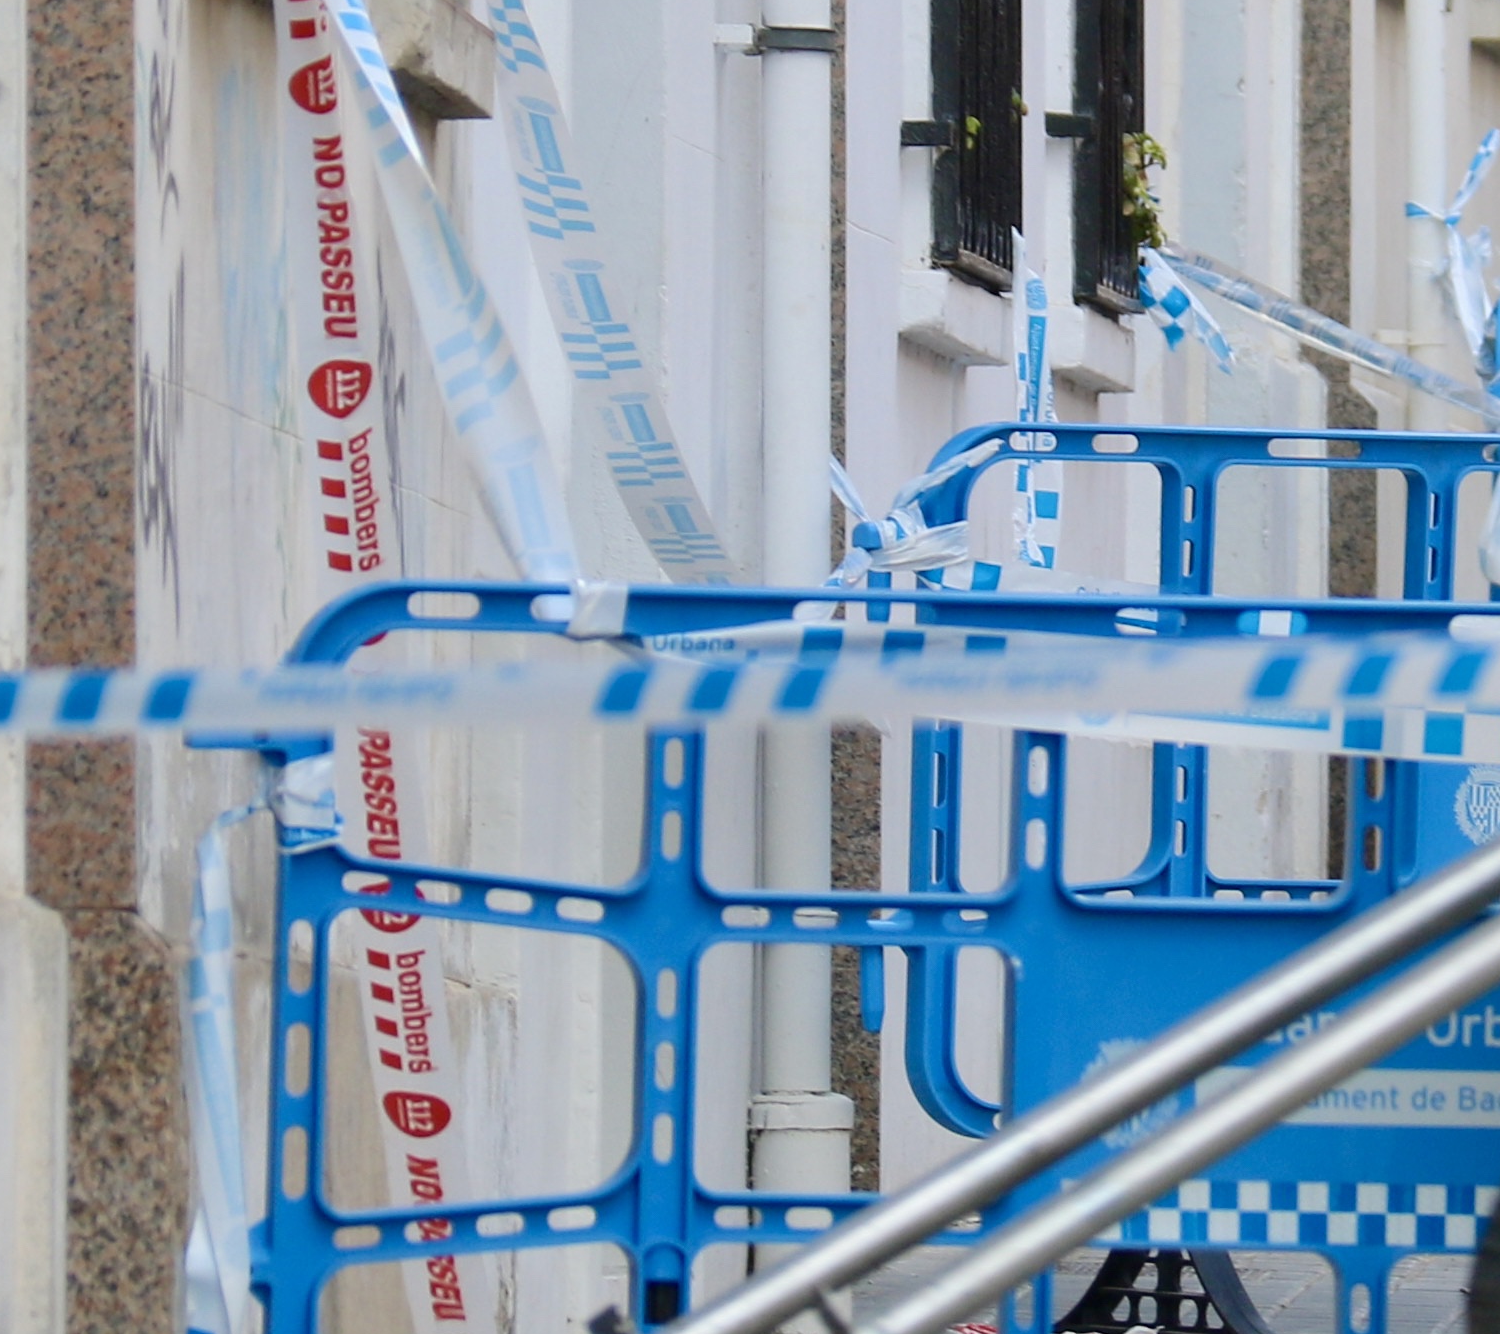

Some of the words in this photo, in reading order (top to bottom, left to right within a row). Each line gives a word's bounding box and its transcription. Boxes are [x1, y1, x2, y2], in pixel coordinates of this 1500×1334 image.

[312, 135, 345, 191] NO
[316, 199, 358, 341] PASSEU
[334, 368, 361, 410] 112
[348, 426, 384, 573] bombers
[358, 726, 403, 861] PASSEU
[396, 948, 433, 1075] bombers
[405, 1099, 434, 1131] 112
[1410, 1085, 1447, 1112] de
[405, 1154, 444, 1201] NO
